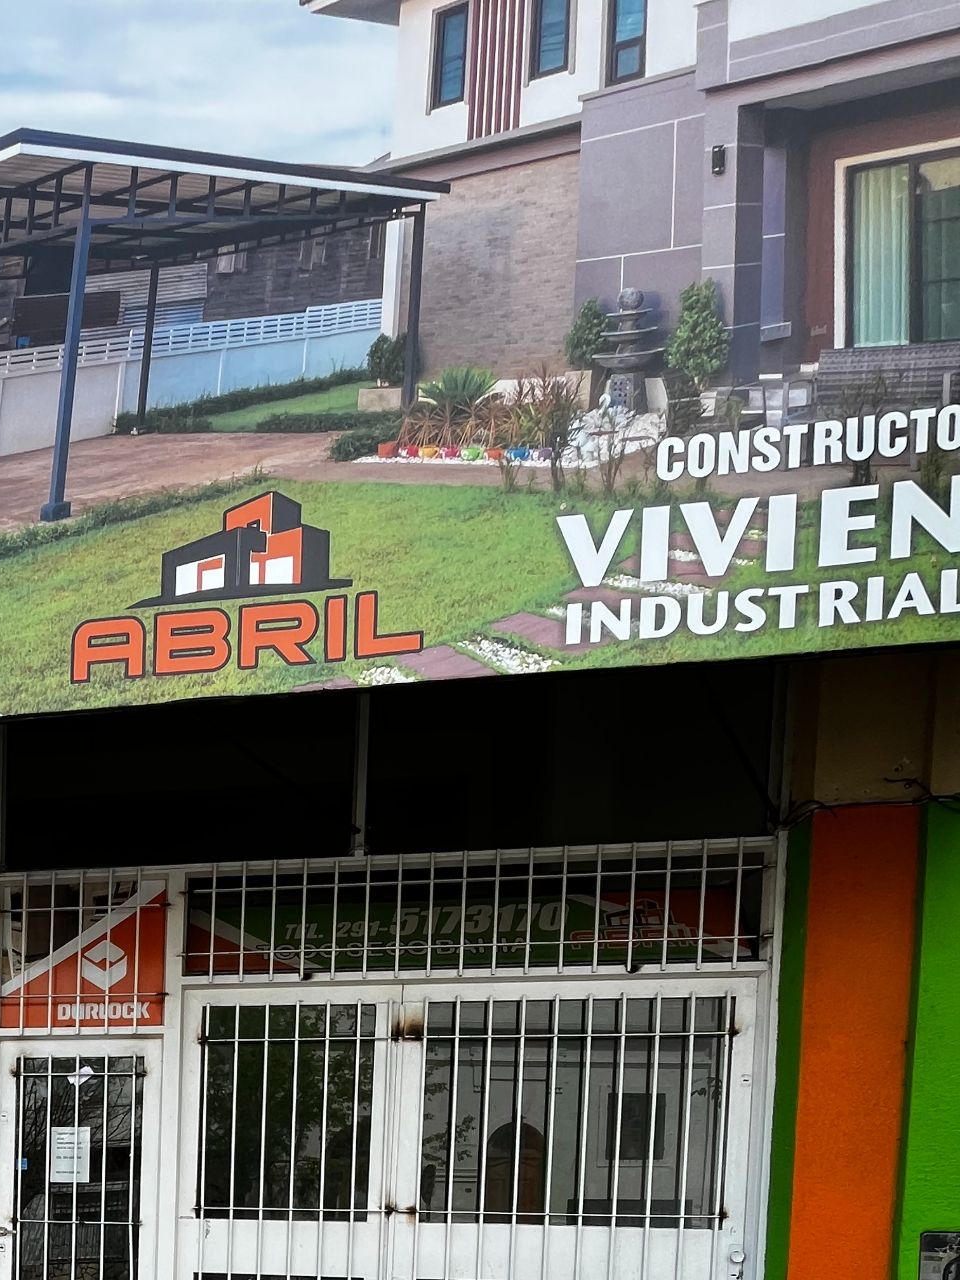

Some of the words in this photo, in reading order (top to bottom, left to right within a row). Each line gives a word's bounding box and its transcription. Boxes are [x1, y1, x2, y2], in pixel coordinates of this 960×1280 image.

[657, 404, 960, 482] CONSTRUCTO
[556, 474, 960, 589] VIVIEN
[70, 590, 425, 685] ABRIL
[565, 568, 960, 646] INDUSTRIAL
[284, 922, 324, 940] TEL.
[336, 902, 569, 938] 291-5173170
[346, 940, 429, 958] SECO
[57, 1001, 150, 1020] DURLOCK
